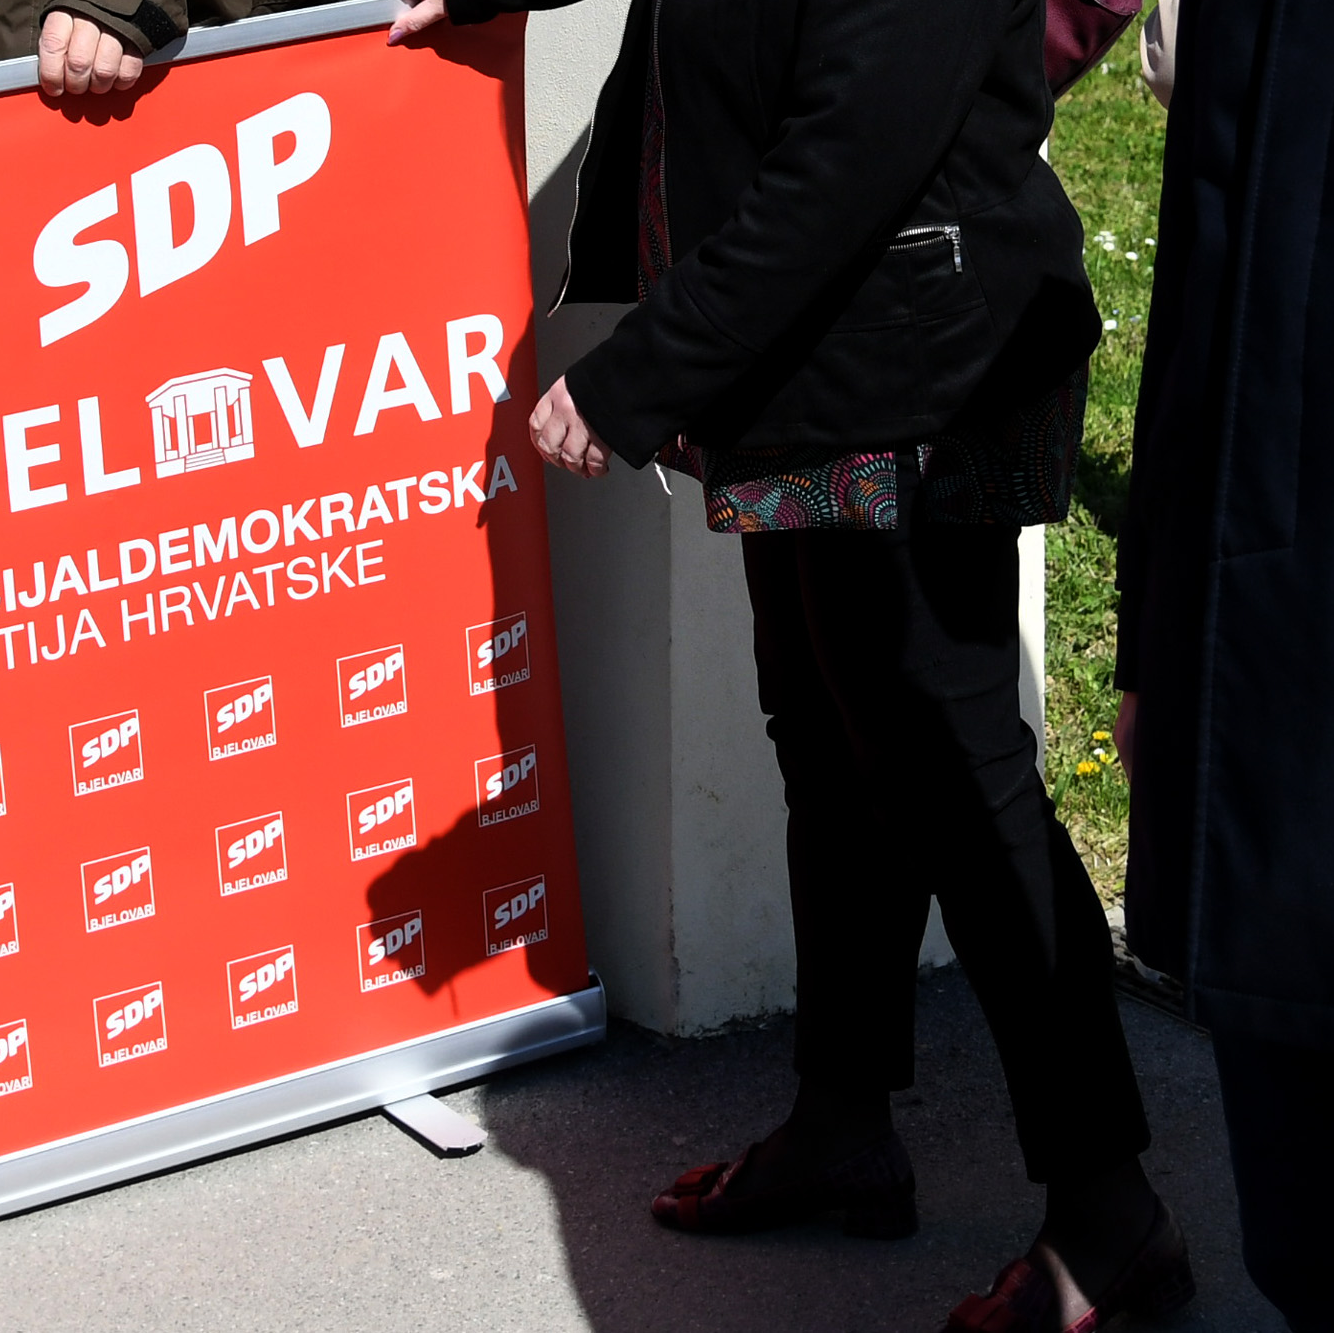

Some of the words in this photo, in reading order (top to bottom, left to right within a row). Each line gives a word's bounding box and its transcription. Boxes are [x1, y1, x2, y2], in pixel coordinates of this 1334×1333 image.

[33, 92, 332, 347] SDP
[121, 540, 387, 643] HRVATSKE
[476, 618, 525, 669] SDP
[348, 651, 402, 700] SDP
[472, 666, 528, 694] BJELOVAR
[216, 683, 271, 733] SDP
[344, 700, 405, 725] BJELOVAR
[81, 717, 139, 768] SDP
[212, 732, 274, 759] BJELOVAR
[77, 766, 142, 793] BJELOVAR
[485, 751, 534, 800] SDP
[359, 785, 412, 834] SDP
[481, 798, 537, 824] BJELOVAR
[227, 818, 283, 868] SDP
[354, 832, 415, 859] BJELOVAR
[93, 854, 150, 904] SDP
[223, 867, 286, 893] BJELOVAR
[89, 902, 153, 930] BJELOVAR
[493, 882, 544, 931] SDP
[368, 917, 421, 966] SDP
[489, 927, 546, 954] BJELOVAR
[238, 951, 293, 1002] SDP
[364, 963, 423, 990] BJELOVAR
[105, 989, 162, 1040] SDP
[235, 999, 297, 1027] BJELOVAR
[102, 1037, 165, 1065] BJELOVAR
